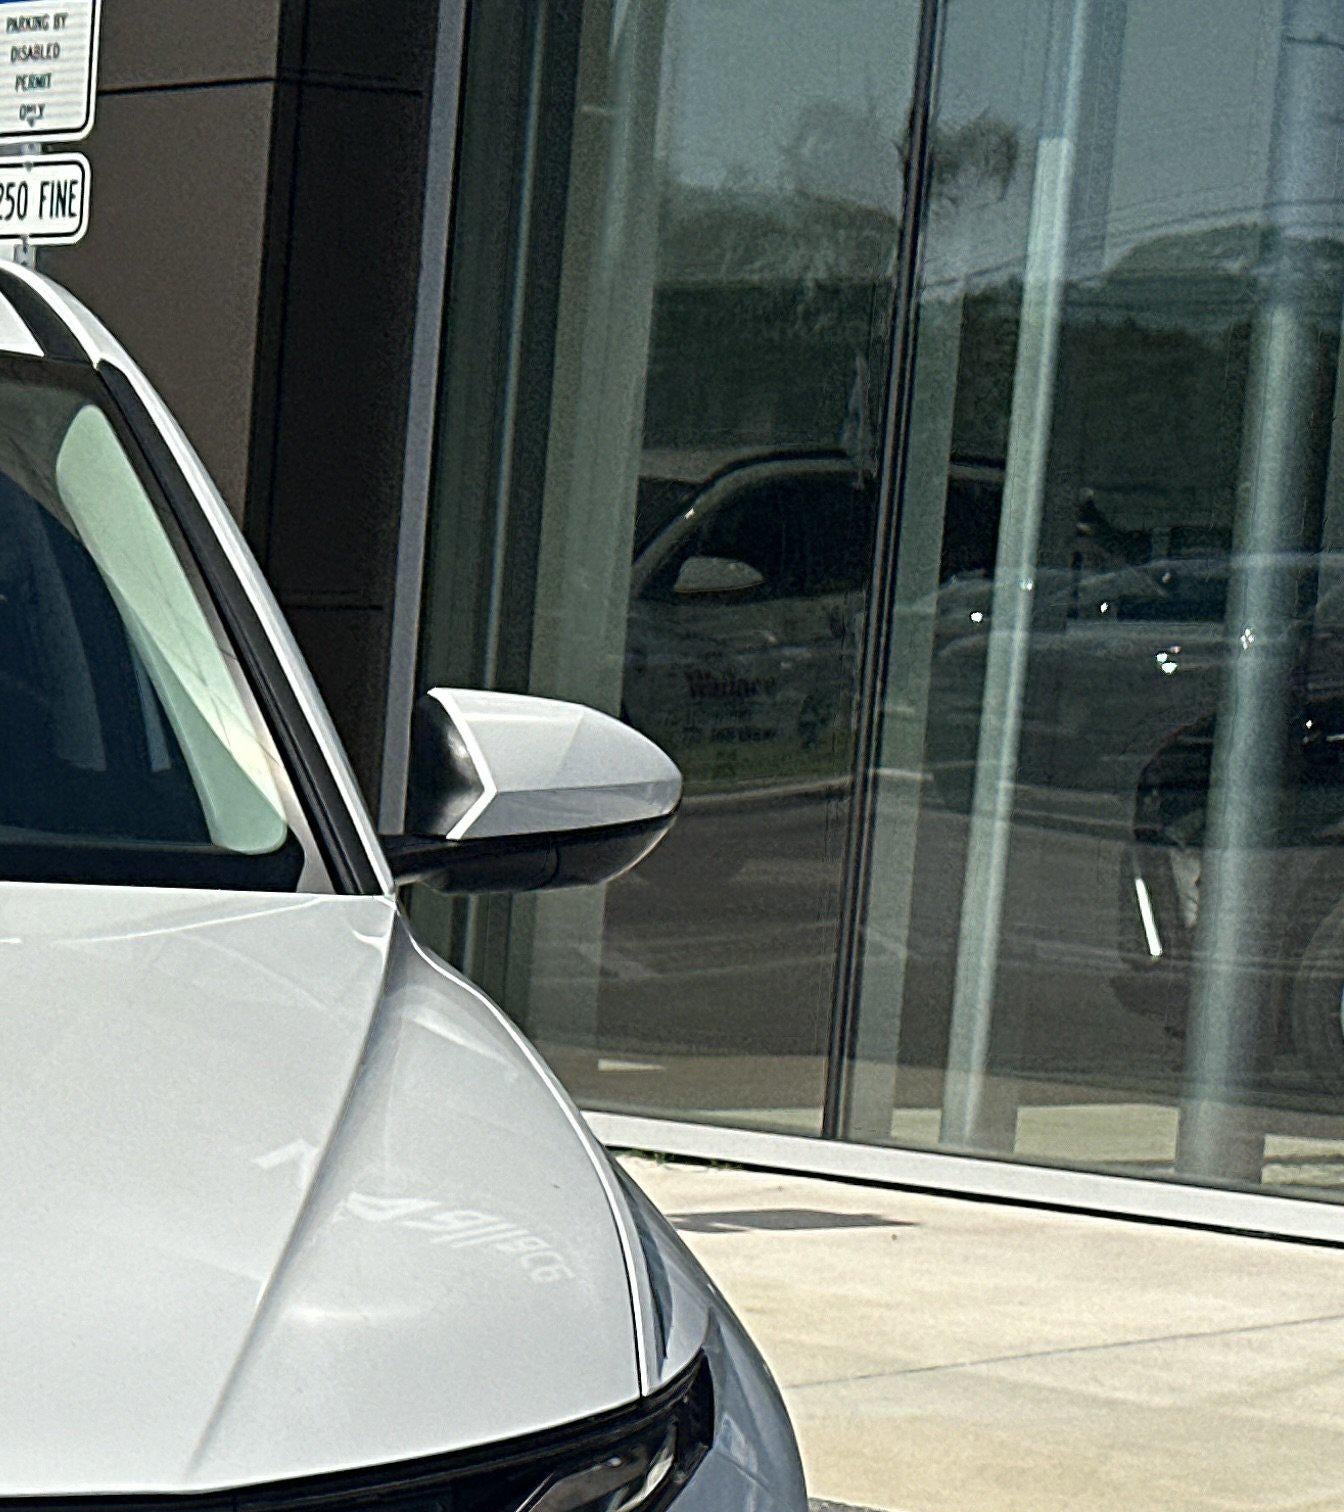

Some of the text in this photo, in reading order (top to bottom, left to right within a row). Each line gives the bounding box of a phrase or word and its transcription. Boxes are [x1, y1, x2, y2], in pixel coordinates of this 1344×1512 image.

[6, 12, 68, 33] PARKING BY
[10, 42, 60, 63] DISABLED
[15, 72, 52, 92] PERMIT
[39, 179, 79, 219] FINE
